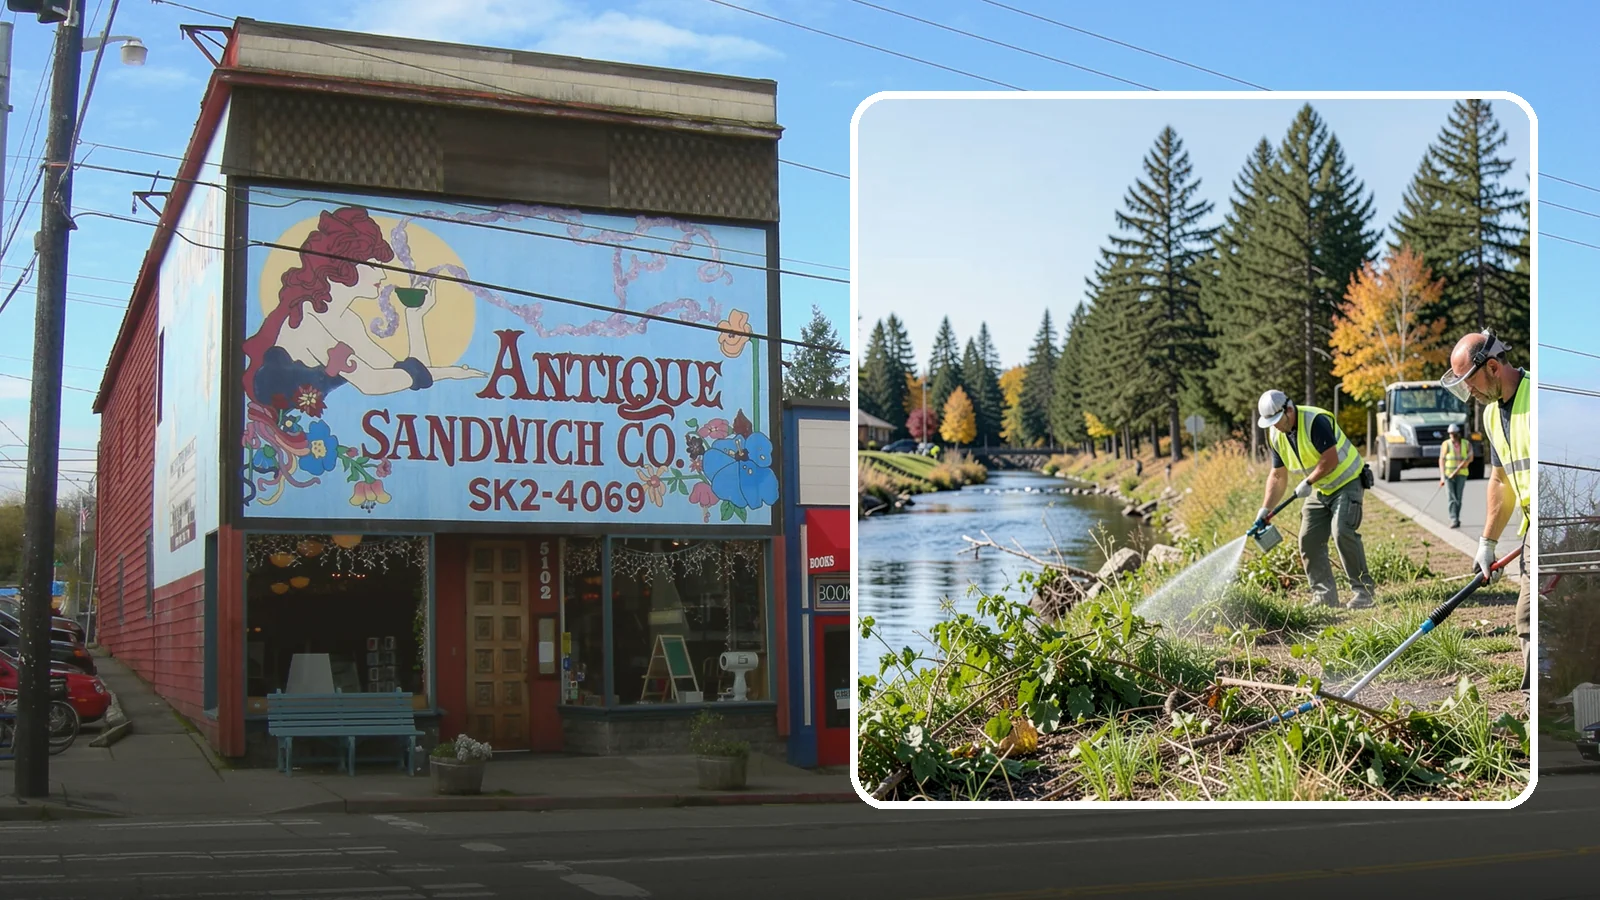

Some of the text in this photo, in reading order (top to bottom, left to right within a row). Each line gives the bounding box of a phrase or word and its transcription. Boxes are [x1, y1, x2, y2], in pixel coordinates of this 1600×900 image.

[476, 329, 723, 420] ANTIQUE
[362, 408, 685, 469] SANDWICH CO.
[468, 477, 646, 514] SK2-4069
[540, 542, 552, 599] 5102
[809, 555, 835, 569] BOOKS
